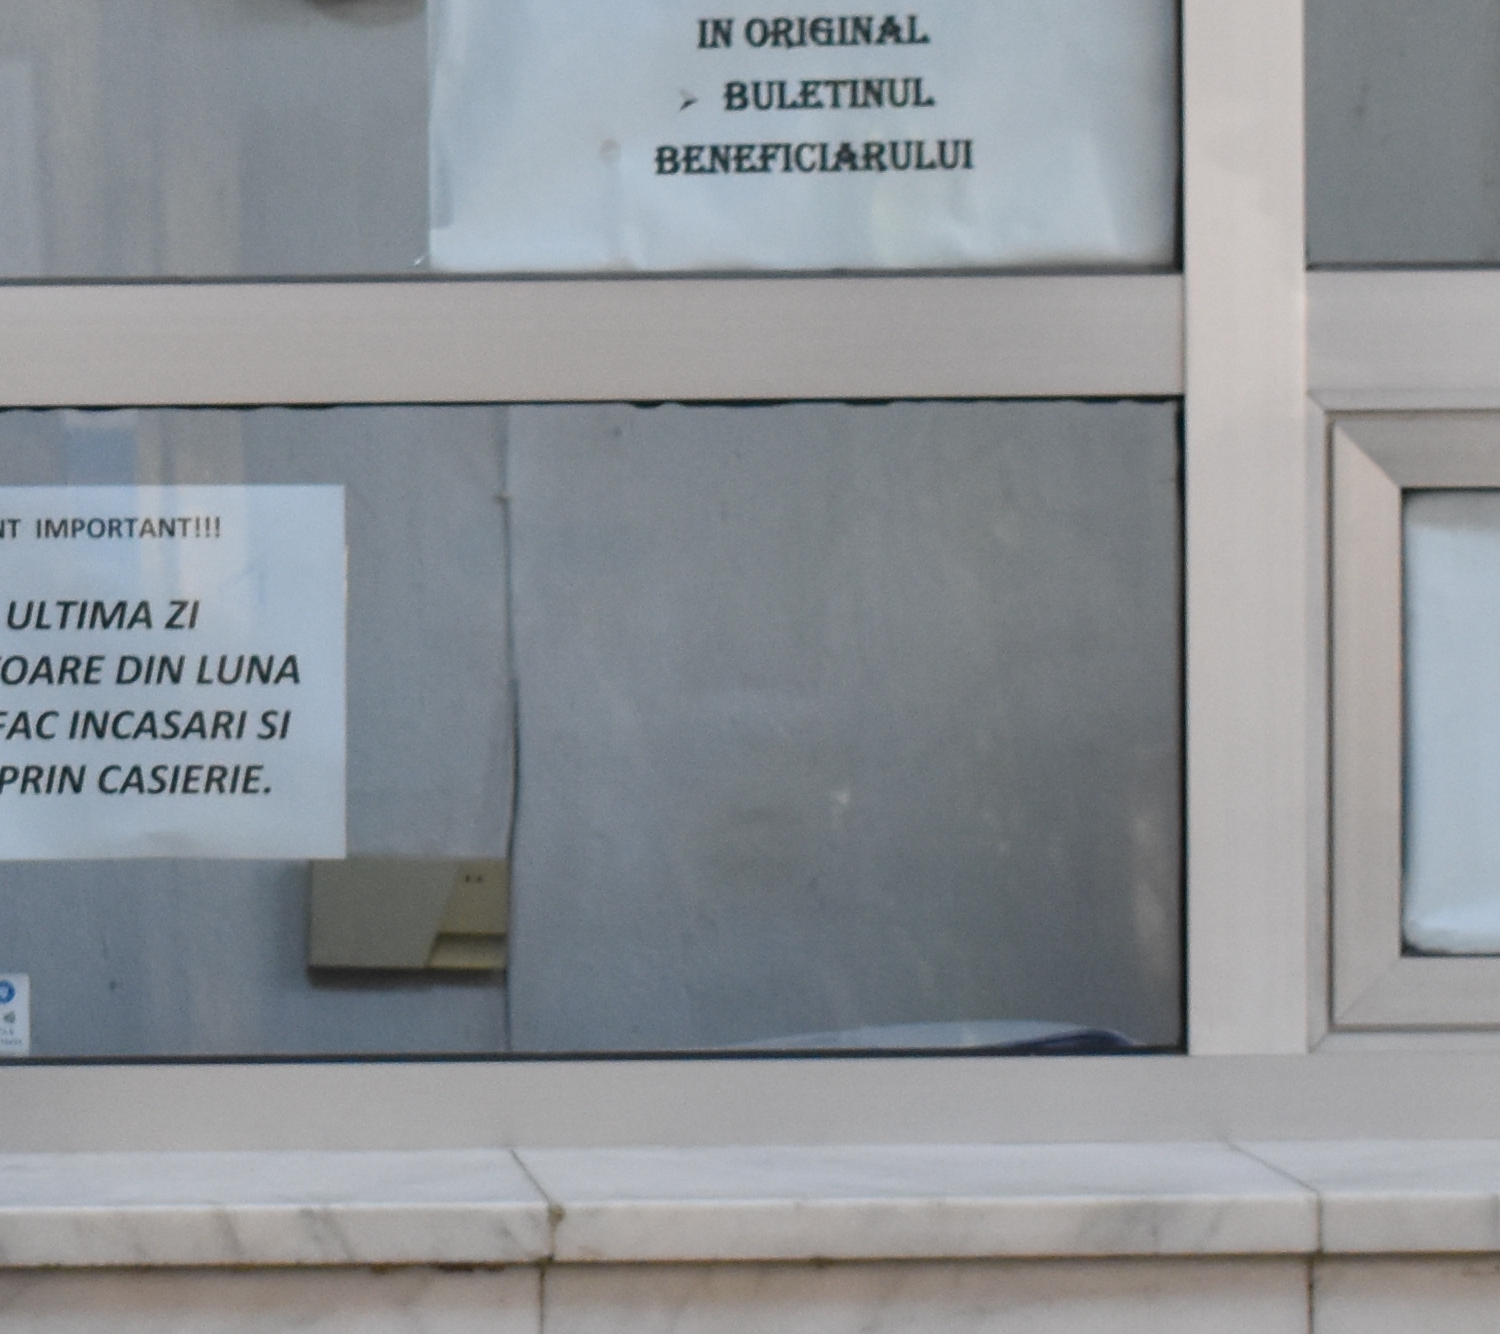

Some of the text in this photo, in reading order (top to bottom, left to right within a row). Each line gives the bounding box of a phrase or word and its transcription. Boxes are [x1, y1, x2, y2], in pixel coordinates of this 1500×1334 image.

[698, 15, 930, 48] IN ORIGINAL
[724, 78, 935, 111] BULETINUL
[655, 140, 972, 175] BENEFICIARULUI
[36, 517, 220, 538] IMPORTANT!!!
[7, 601, 152, 630] ULTIMA
[165, 600, 199, 629] ZI
[116, 656, 185, 684] DIN
[197, 655, 299, 685] LUNA
[69, 710, 246, 740] INCASARI
[258, 710, 290, 740] SI
[98, 765, 270, 794] CASIERIE.
